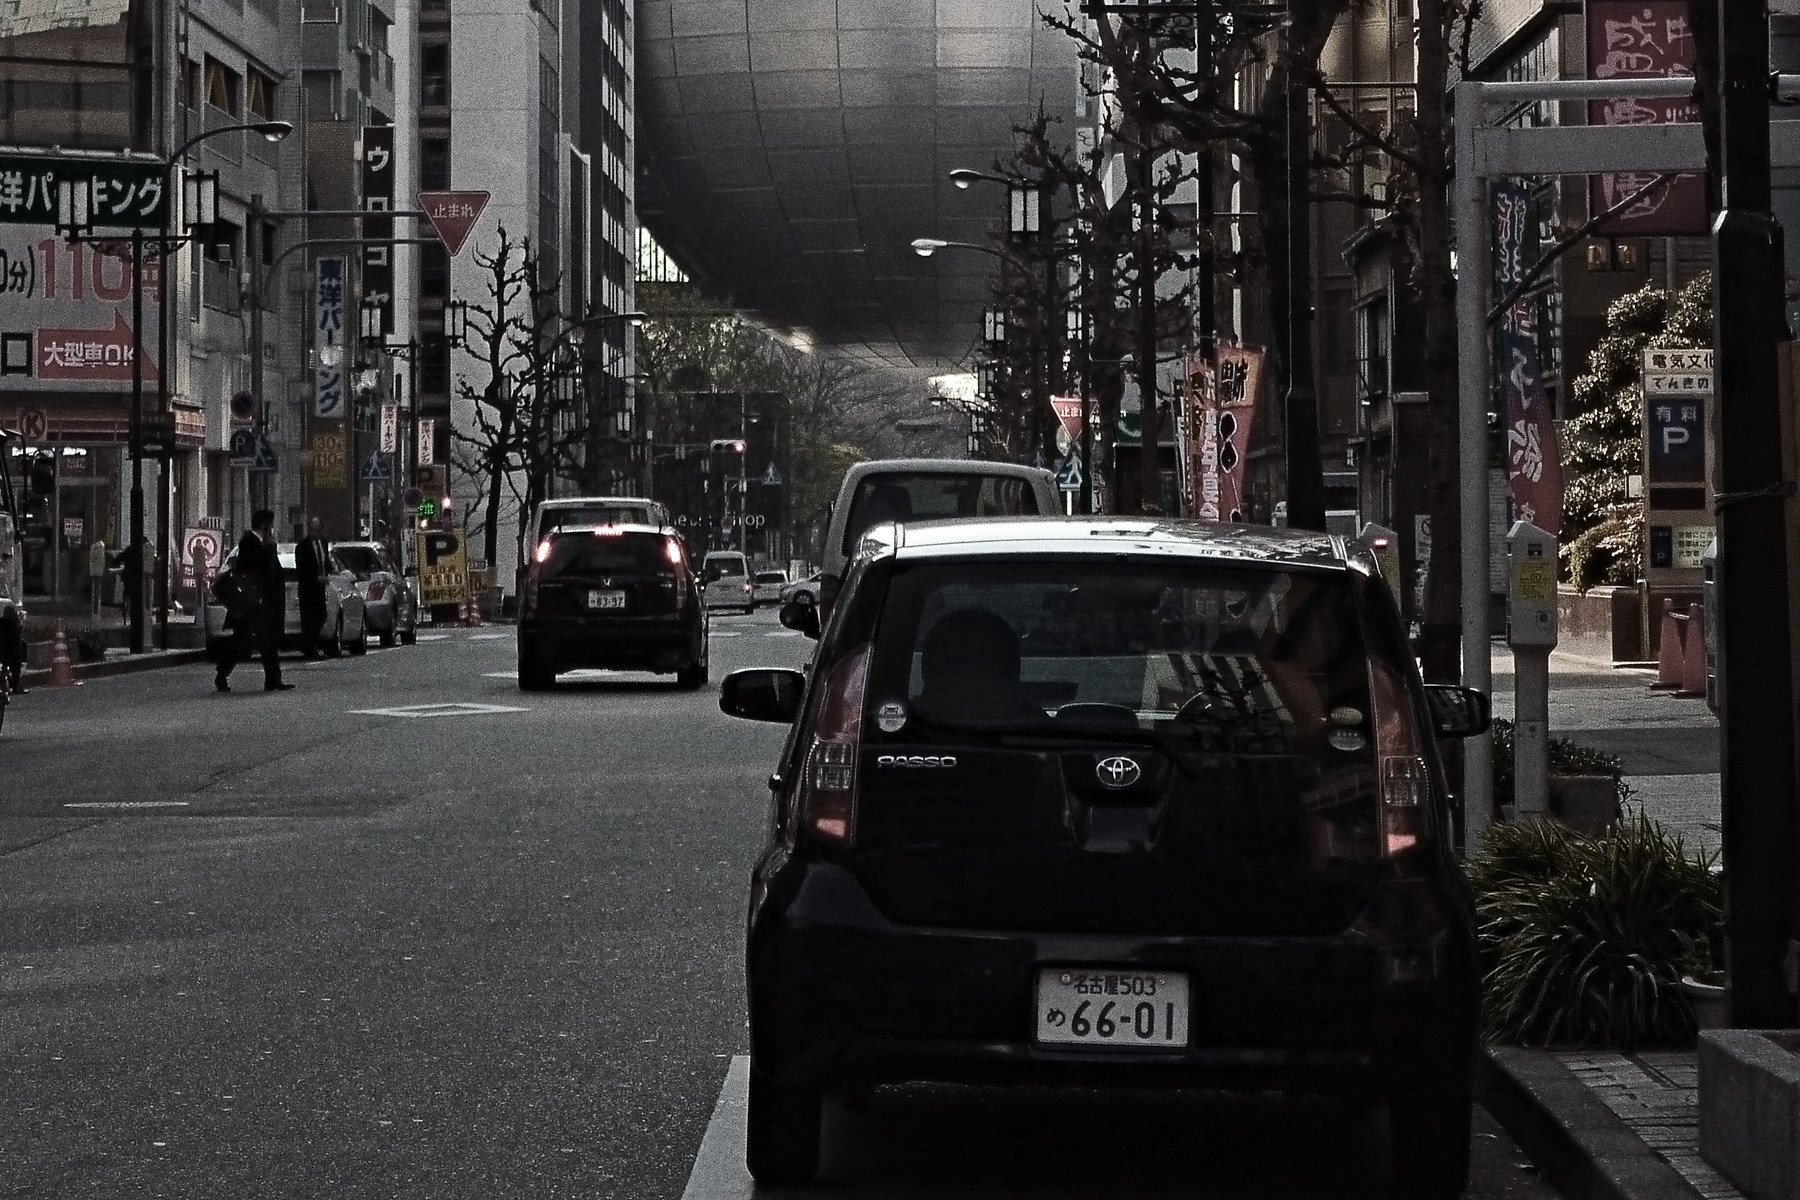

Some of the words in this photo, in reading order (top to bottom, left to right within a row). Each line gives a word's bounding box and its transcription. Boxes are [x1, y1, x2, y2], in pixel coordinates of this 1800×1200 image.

[0, 169, 162, 217] 洋パキング
[432, 203, 475, 220] 止まれ
[318, 260, 341, 415] 東洋パーング
[44, 341, 134, 367] 大型車OK
[1060, 407, 1083, 418] 止ま
[1656, 406, 1697, 423] 有料
[235, 435, 247, 453] P
[1663, 427, 1690, 454] P
[426, 534, 459, 566] P
[878, 755, 957, 769] PASSO
[1074, 974, 1157, 996] 名古屋503
[1047, 1007, 1066, 1028] め
[1071, 1000, 1174, 1041] 66-01
